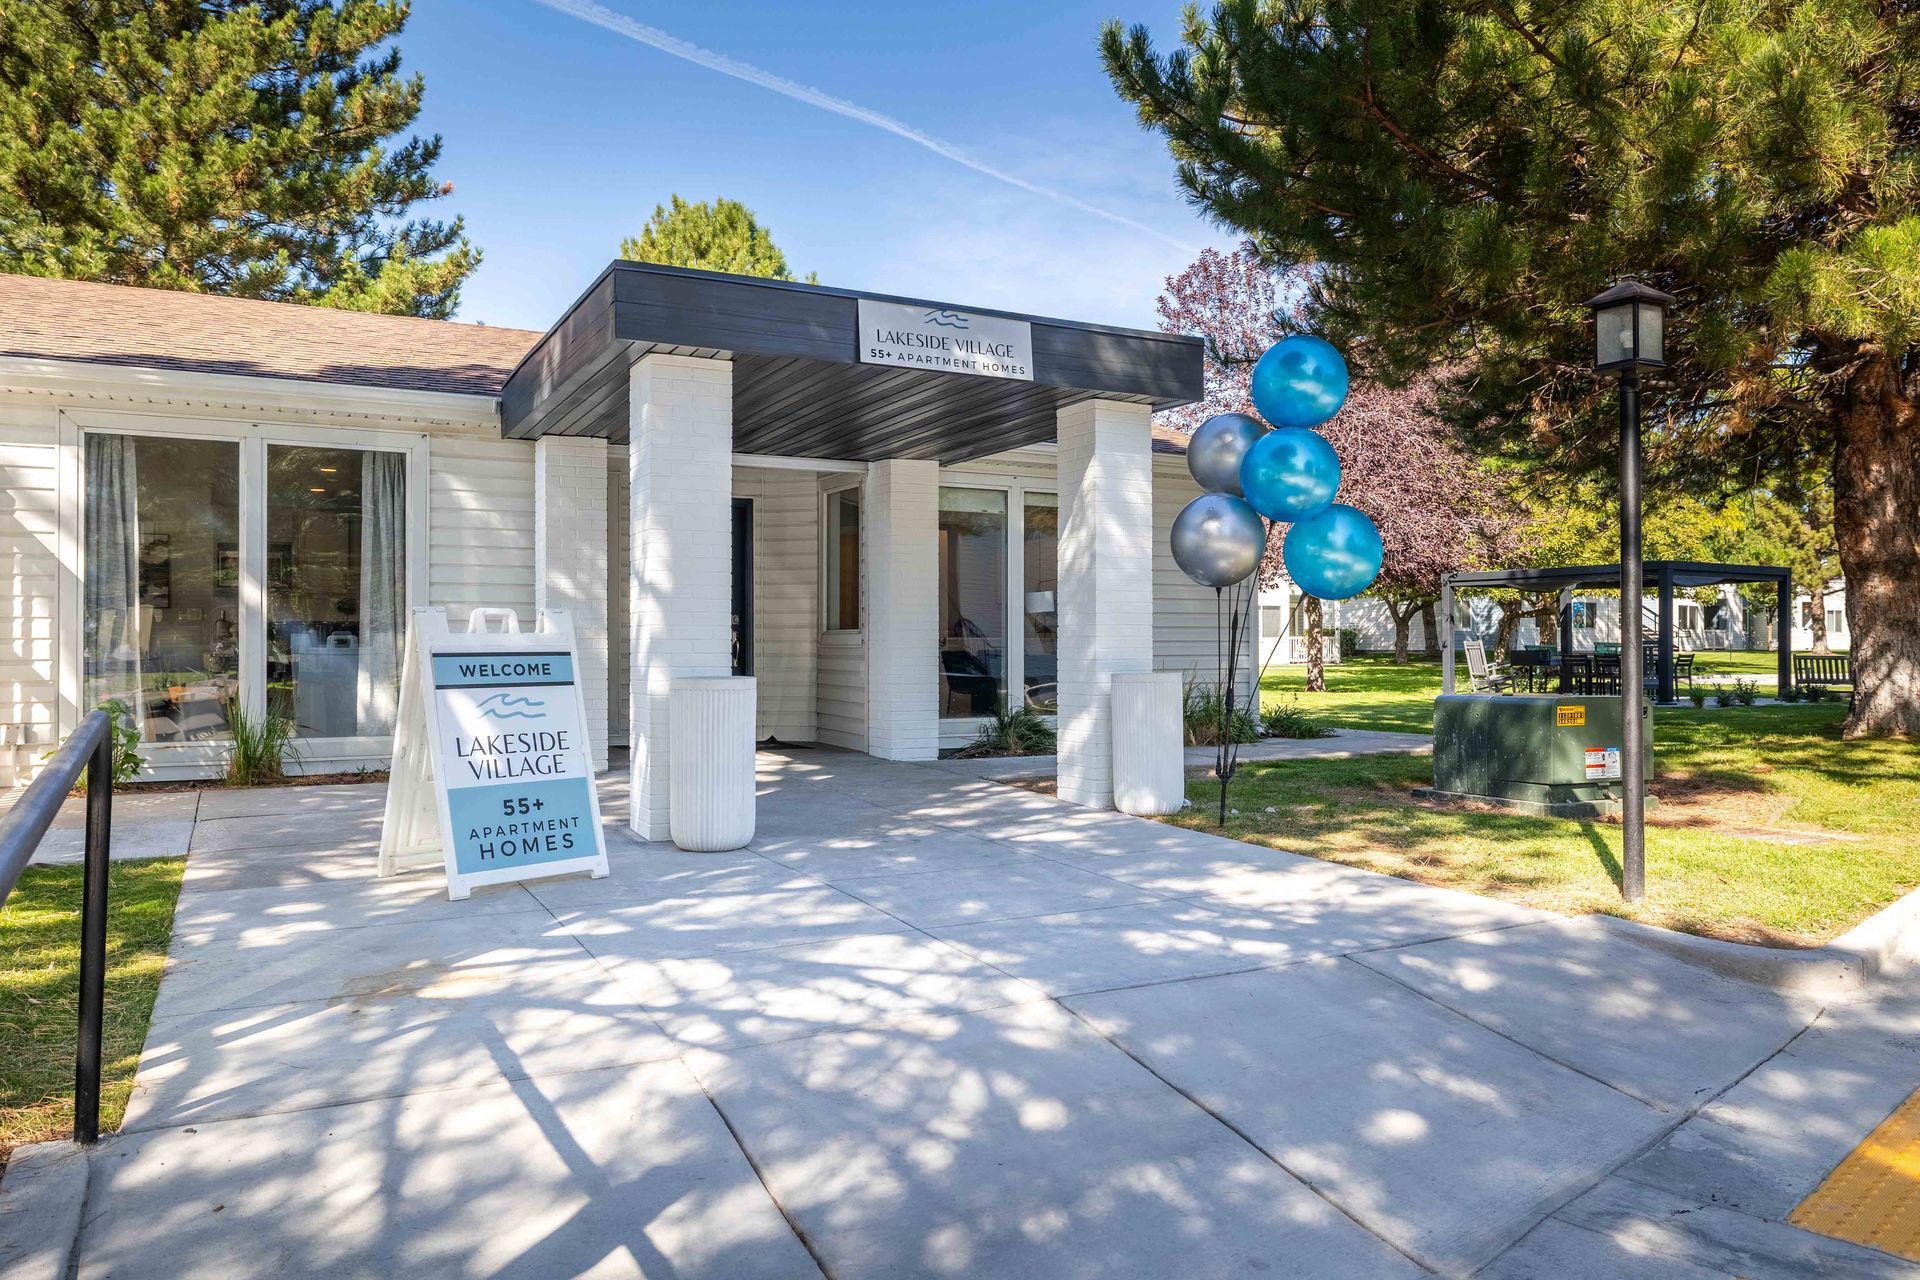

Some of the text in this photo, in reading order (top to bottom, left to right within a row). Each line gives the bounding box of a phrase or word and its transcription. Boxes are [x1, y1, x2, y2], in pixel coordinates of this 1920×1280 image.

[877, 329, 1014, 358] LAKESIDE VILLAGE
[870, 348, 1025, 374] 55+ APARTMENT HOMES
[459, 663, 552, 678] WELCOME
[456, 730, 570, 758] LAKESIDE
[468, 754, 566, 780] VILLAGE
[503, 798, 544, 816] 55+
[469, 817, 579, 840] APARTMENT
[480, 833, 574, 860] HOMES
